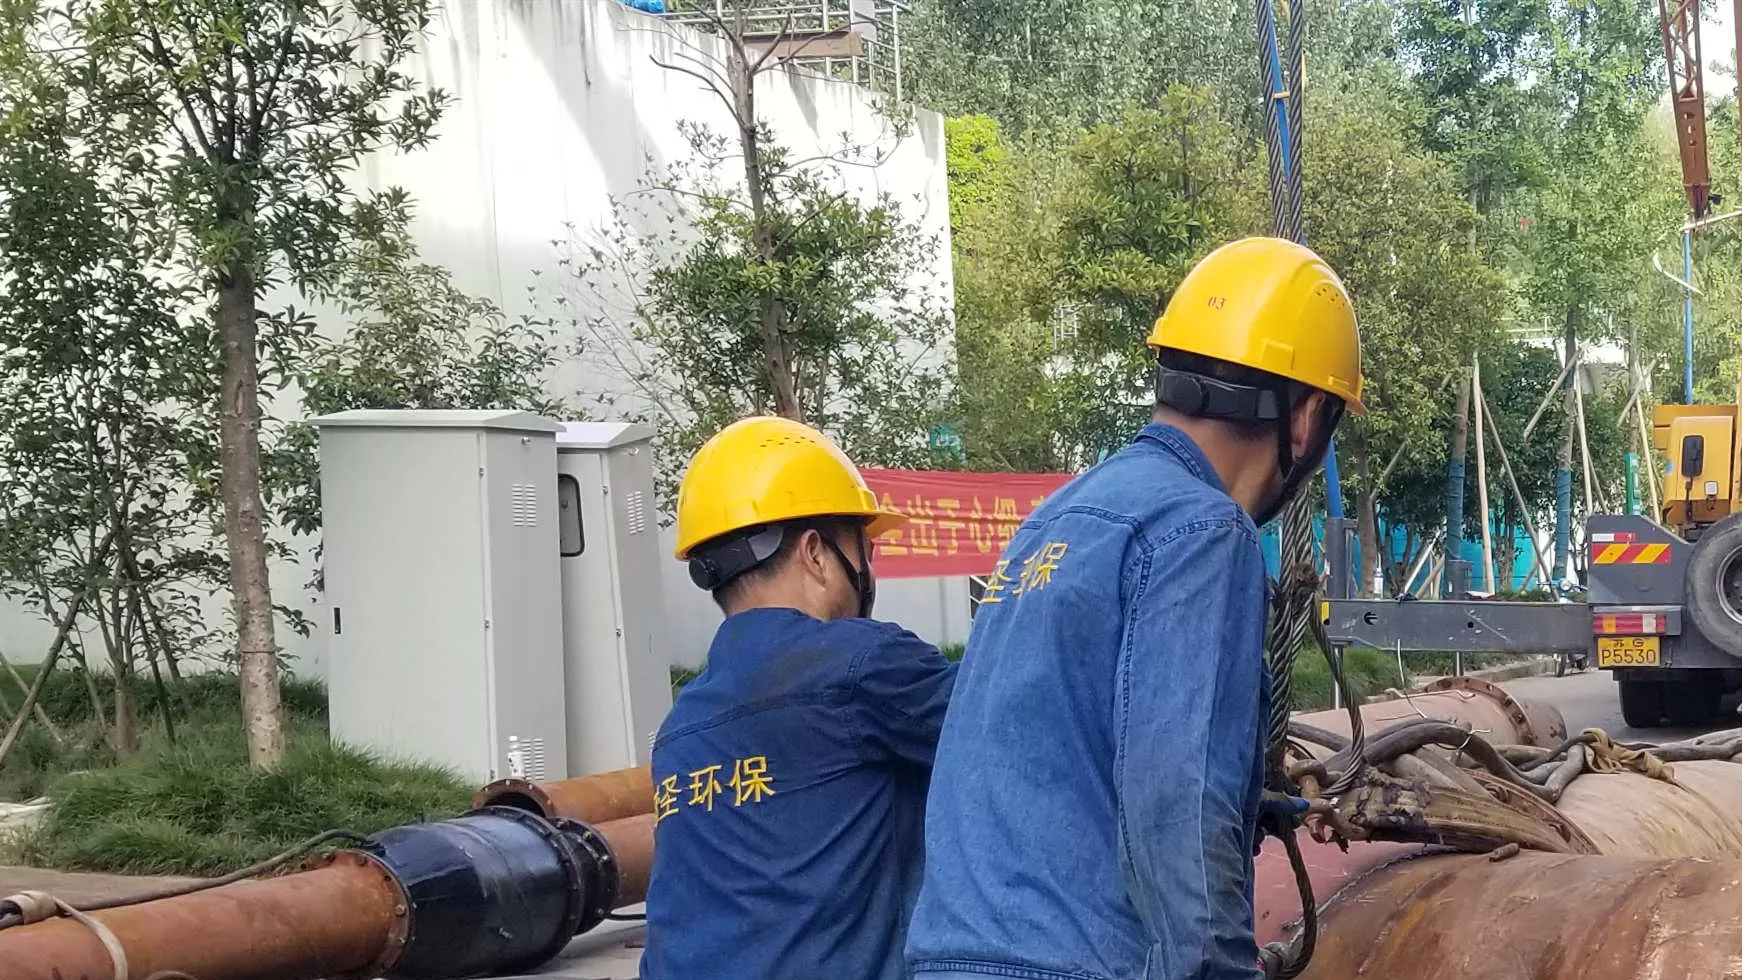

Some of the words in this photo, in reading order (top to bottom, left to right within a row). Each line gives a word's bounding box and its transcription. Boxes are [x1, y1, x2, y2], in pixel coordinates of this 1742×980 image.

[1601, 648, 1657, 664] P5530
[653, 756, 776, 822] 圣环保
